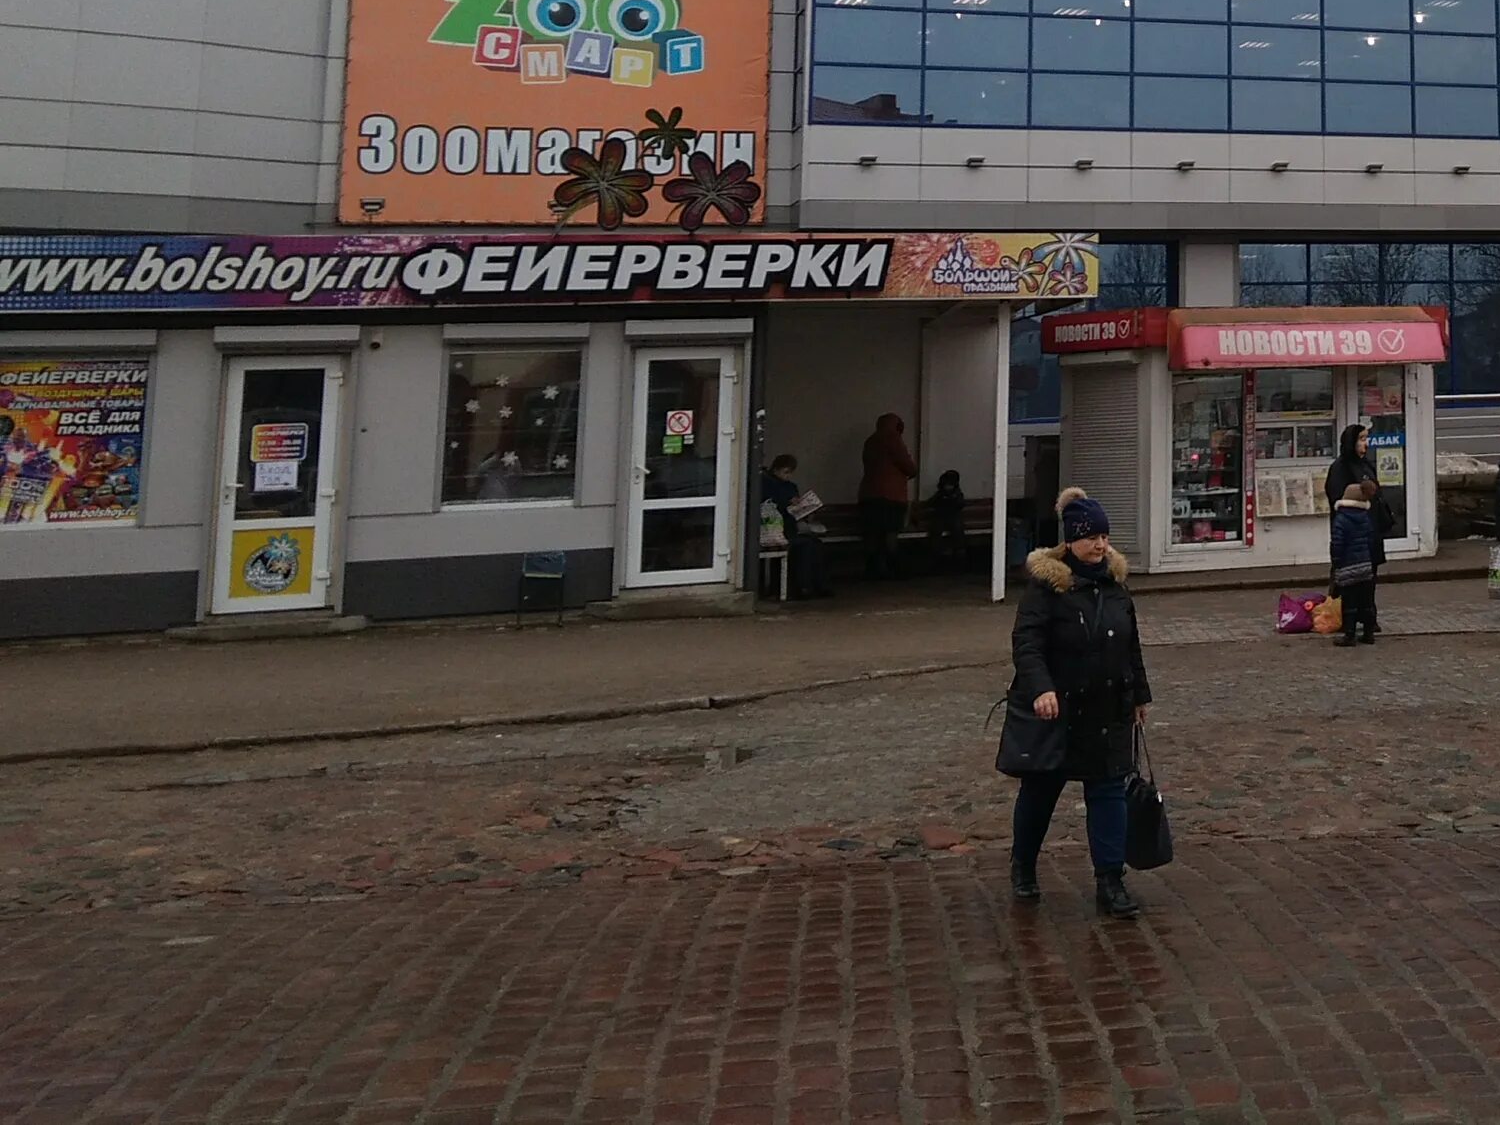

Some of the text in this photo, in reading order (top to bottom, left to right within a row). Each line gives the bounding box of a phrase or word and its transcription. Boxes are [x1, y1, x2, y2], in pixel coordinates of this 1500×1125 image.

[478, 30, 701, 83] СМАРТ
[1055, 322, 1116, 342] НОВОСТИ 39
[1219, 330, 1373, 355] НОВОСТИ 39
[100, 399, 144, 408] ТОВАРЫ
[60, 410, 140, 424] ВСЁ ДЛЯ
[57, 424, 140, 435] ПРАЗДНИКА
[1366, 436, 1400, 446] ТАБАК
